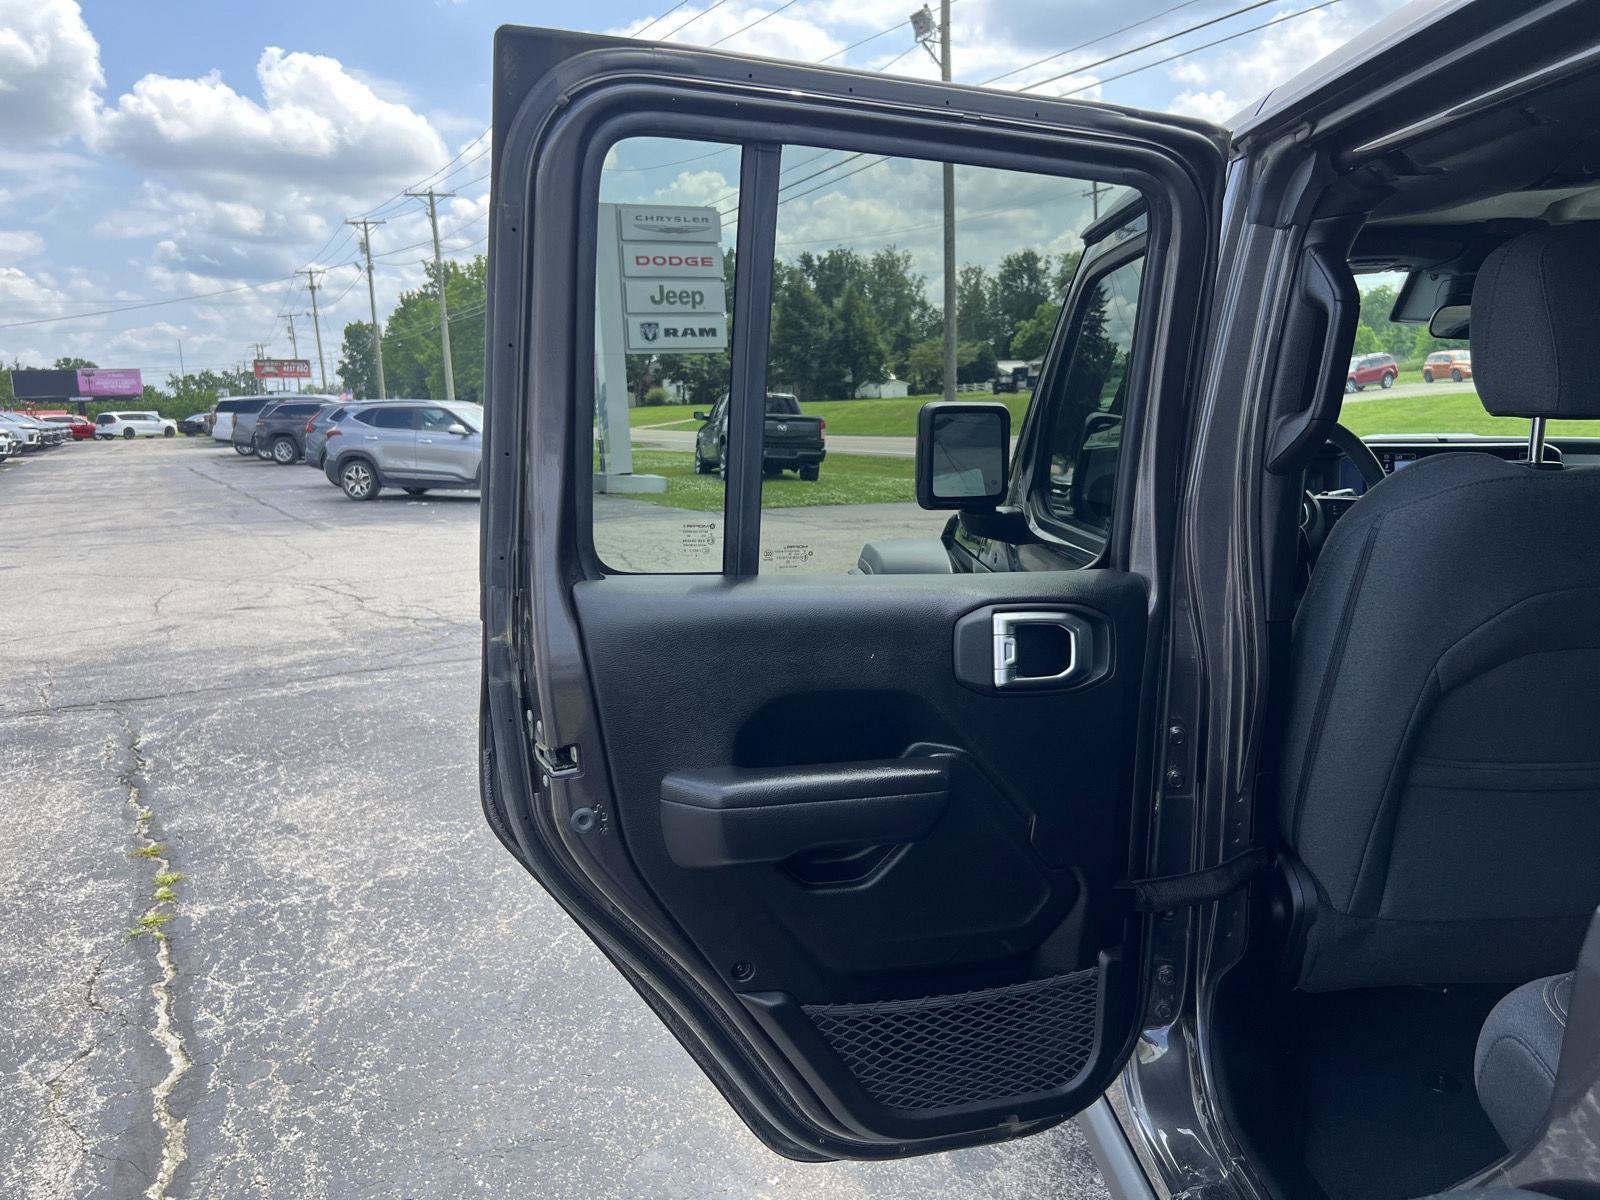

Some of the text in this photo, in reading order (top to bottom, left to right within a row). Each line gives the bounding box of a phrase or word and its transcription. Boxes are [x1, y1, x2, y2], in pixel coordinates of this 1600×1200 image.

[635, 215, 709, 223] CHRYSLER
[635, 256, 714, 267] DODGE
[650, 284, 705, 310] Jeep
[663, 328, 717, 338] RAM
